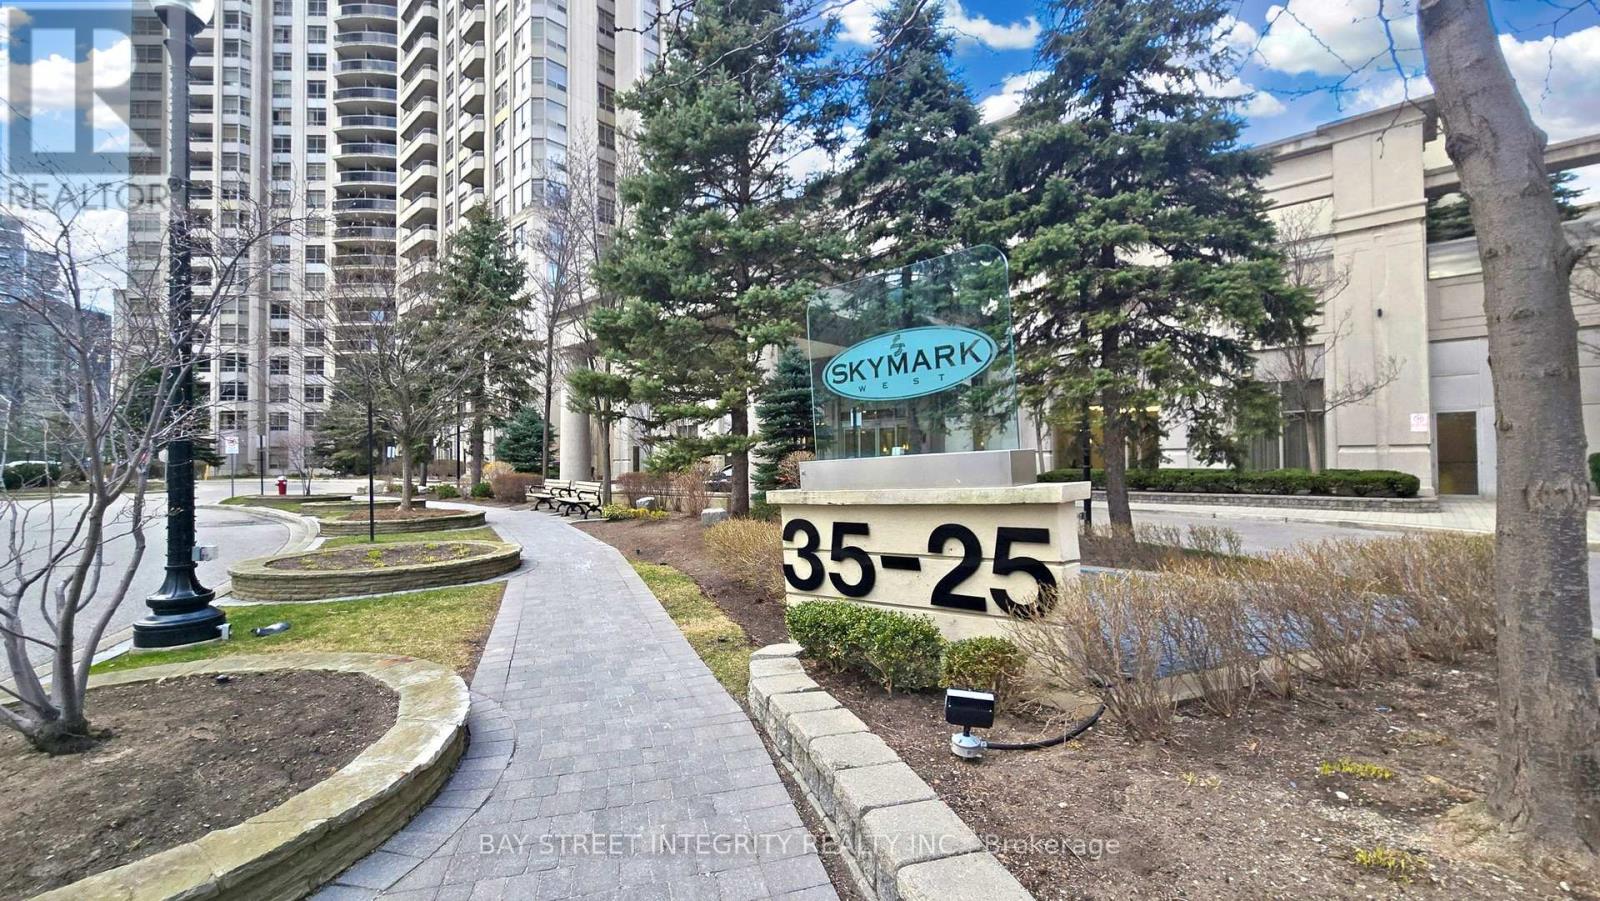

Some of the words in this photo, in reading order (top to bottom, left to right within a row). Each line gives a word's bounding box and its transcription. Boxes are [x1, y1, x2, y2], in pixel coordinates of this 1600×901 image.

[832, 338, 983, 385] SKYMARK
[858, 373, 946, 393] WEST
[783, 518, 1058, 620] 35-25
